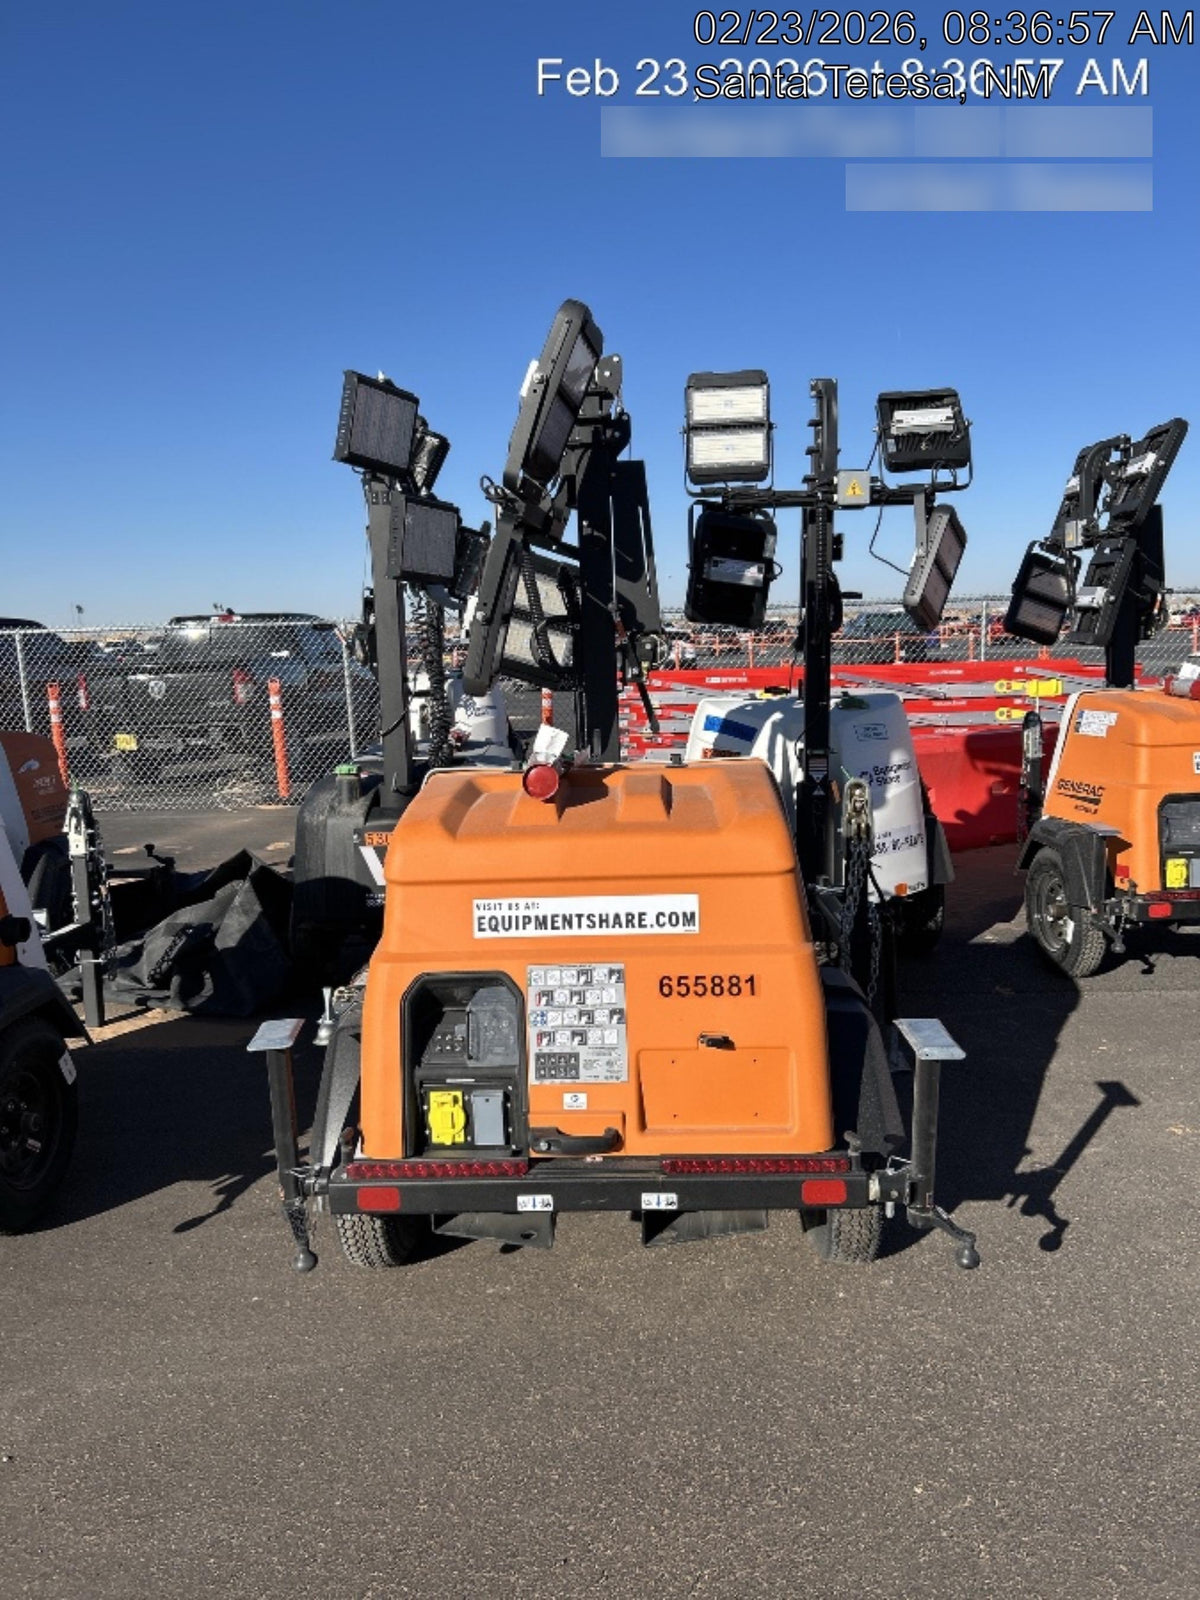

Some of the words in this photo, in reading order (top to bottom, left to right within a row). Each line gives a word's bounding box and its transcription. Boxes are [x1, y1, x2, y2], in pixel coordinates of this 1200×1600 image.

[475, 902, 503, 912] VISIT
[477, 911, 697, 933] EQUIPMENTSHARE.COM
[659, 974, 756, 997] 655881
